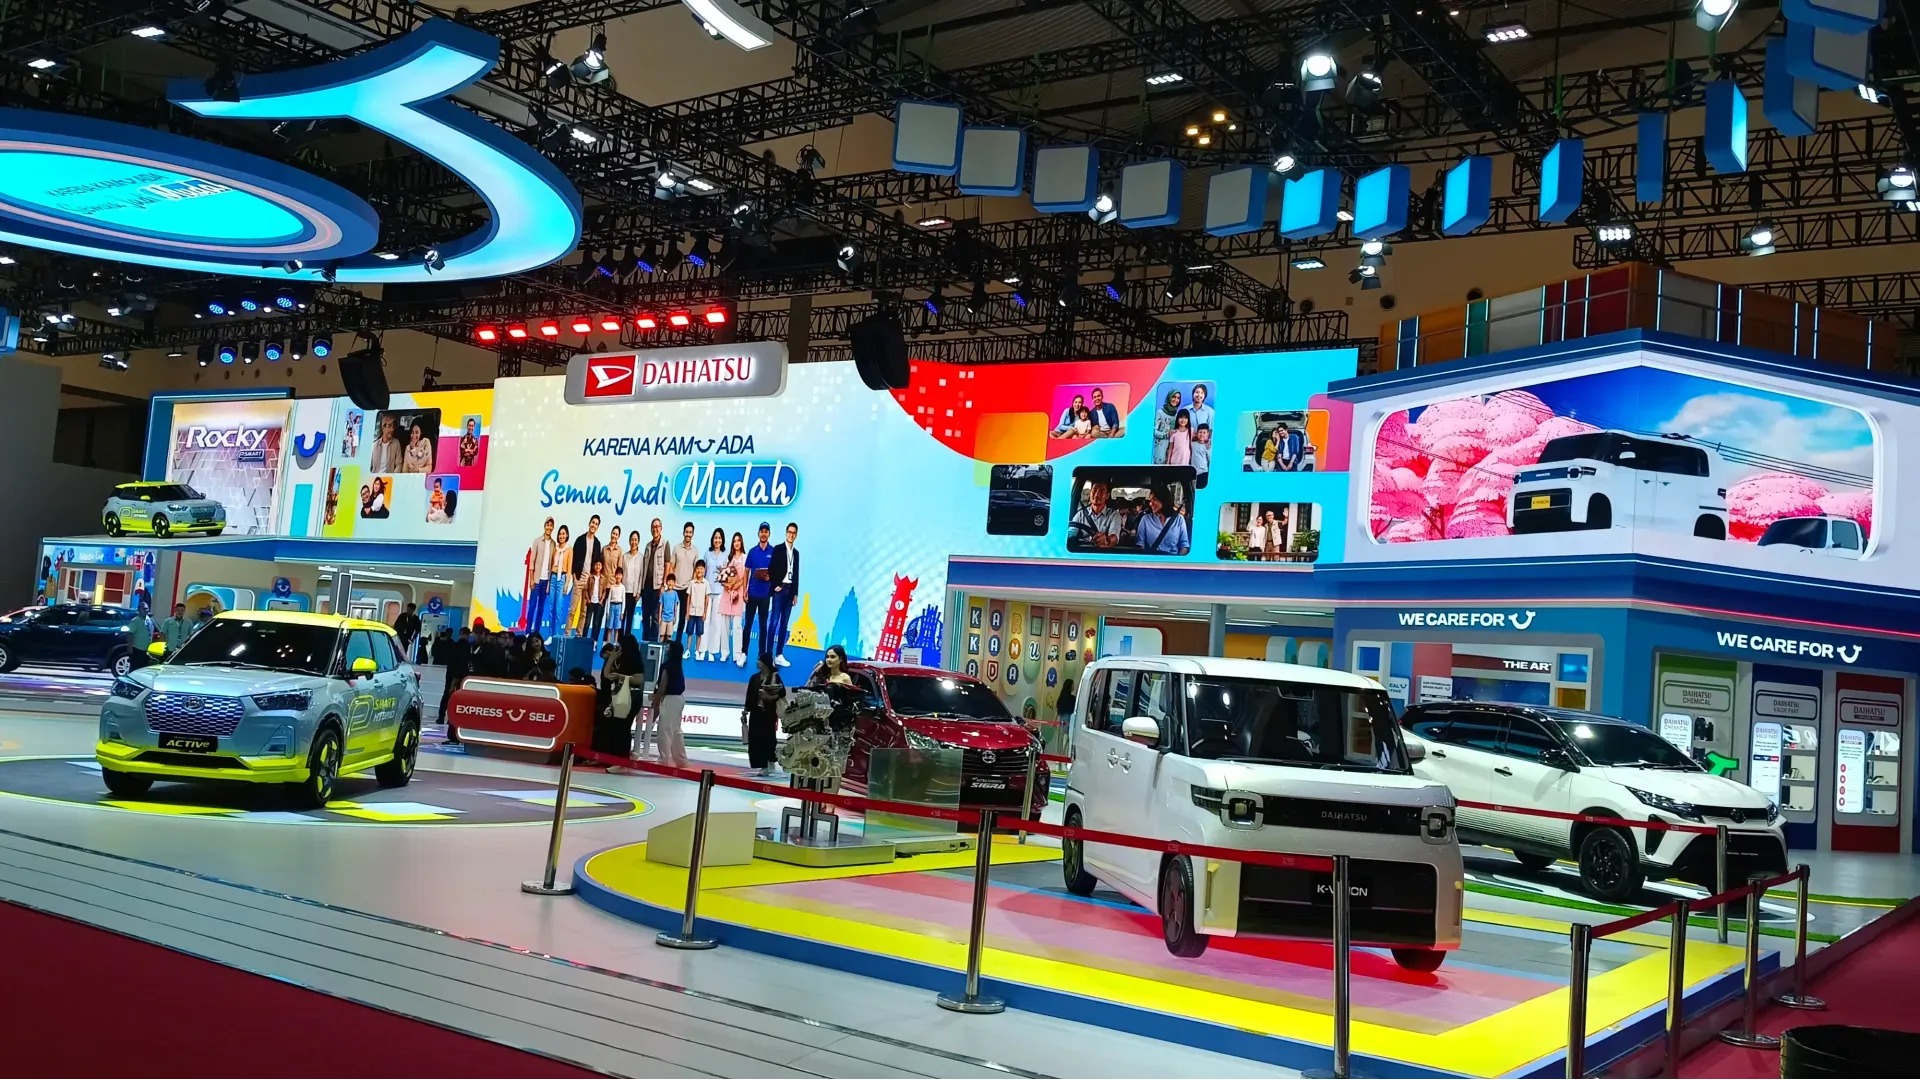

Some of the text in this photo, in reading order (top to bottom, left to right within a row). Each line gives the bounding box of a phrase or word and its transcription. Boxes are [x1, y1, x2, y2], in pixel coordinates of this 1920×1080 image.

[642, 356, 752, 387] DAIHATSU
[185, 423, 268, 450] Rocky
[583, 438, 650, 457] KARENA
[715, 435, 755, 455] ADA
[540, 459, 792, 516] Semua Jadi Mudah
[1398, 612, 1424, 626] WE
[1425, 612, 1469, 627] CARE
[1470, 612, 1505, 627] FOR
[1716, 631, 1748, 649] WE
[1750, 635, 1798, 655] CARE
[1799, 641, 1834, 659] FOR
[1503, 660, 1528, 670] THE
[1682, 690, 1712, 699] DAIHATSU
[1682, 697, 1711, 706] CHEMICAL
[1773, 700, 1800, 708] DAIHATSU
[455, 704, 503, 718] EXPRESS
[528, 712, 556, 723] SELF
[1853, 706, 1886, 716] DAIHATSU
[681, 714, 709, 725] HATSU
[1663, 718, 1690, 726] DAIHATSU
[970, 782, 1006, 790] SIGRA
[1321, 811, 1368, 821] DAIHATSU
